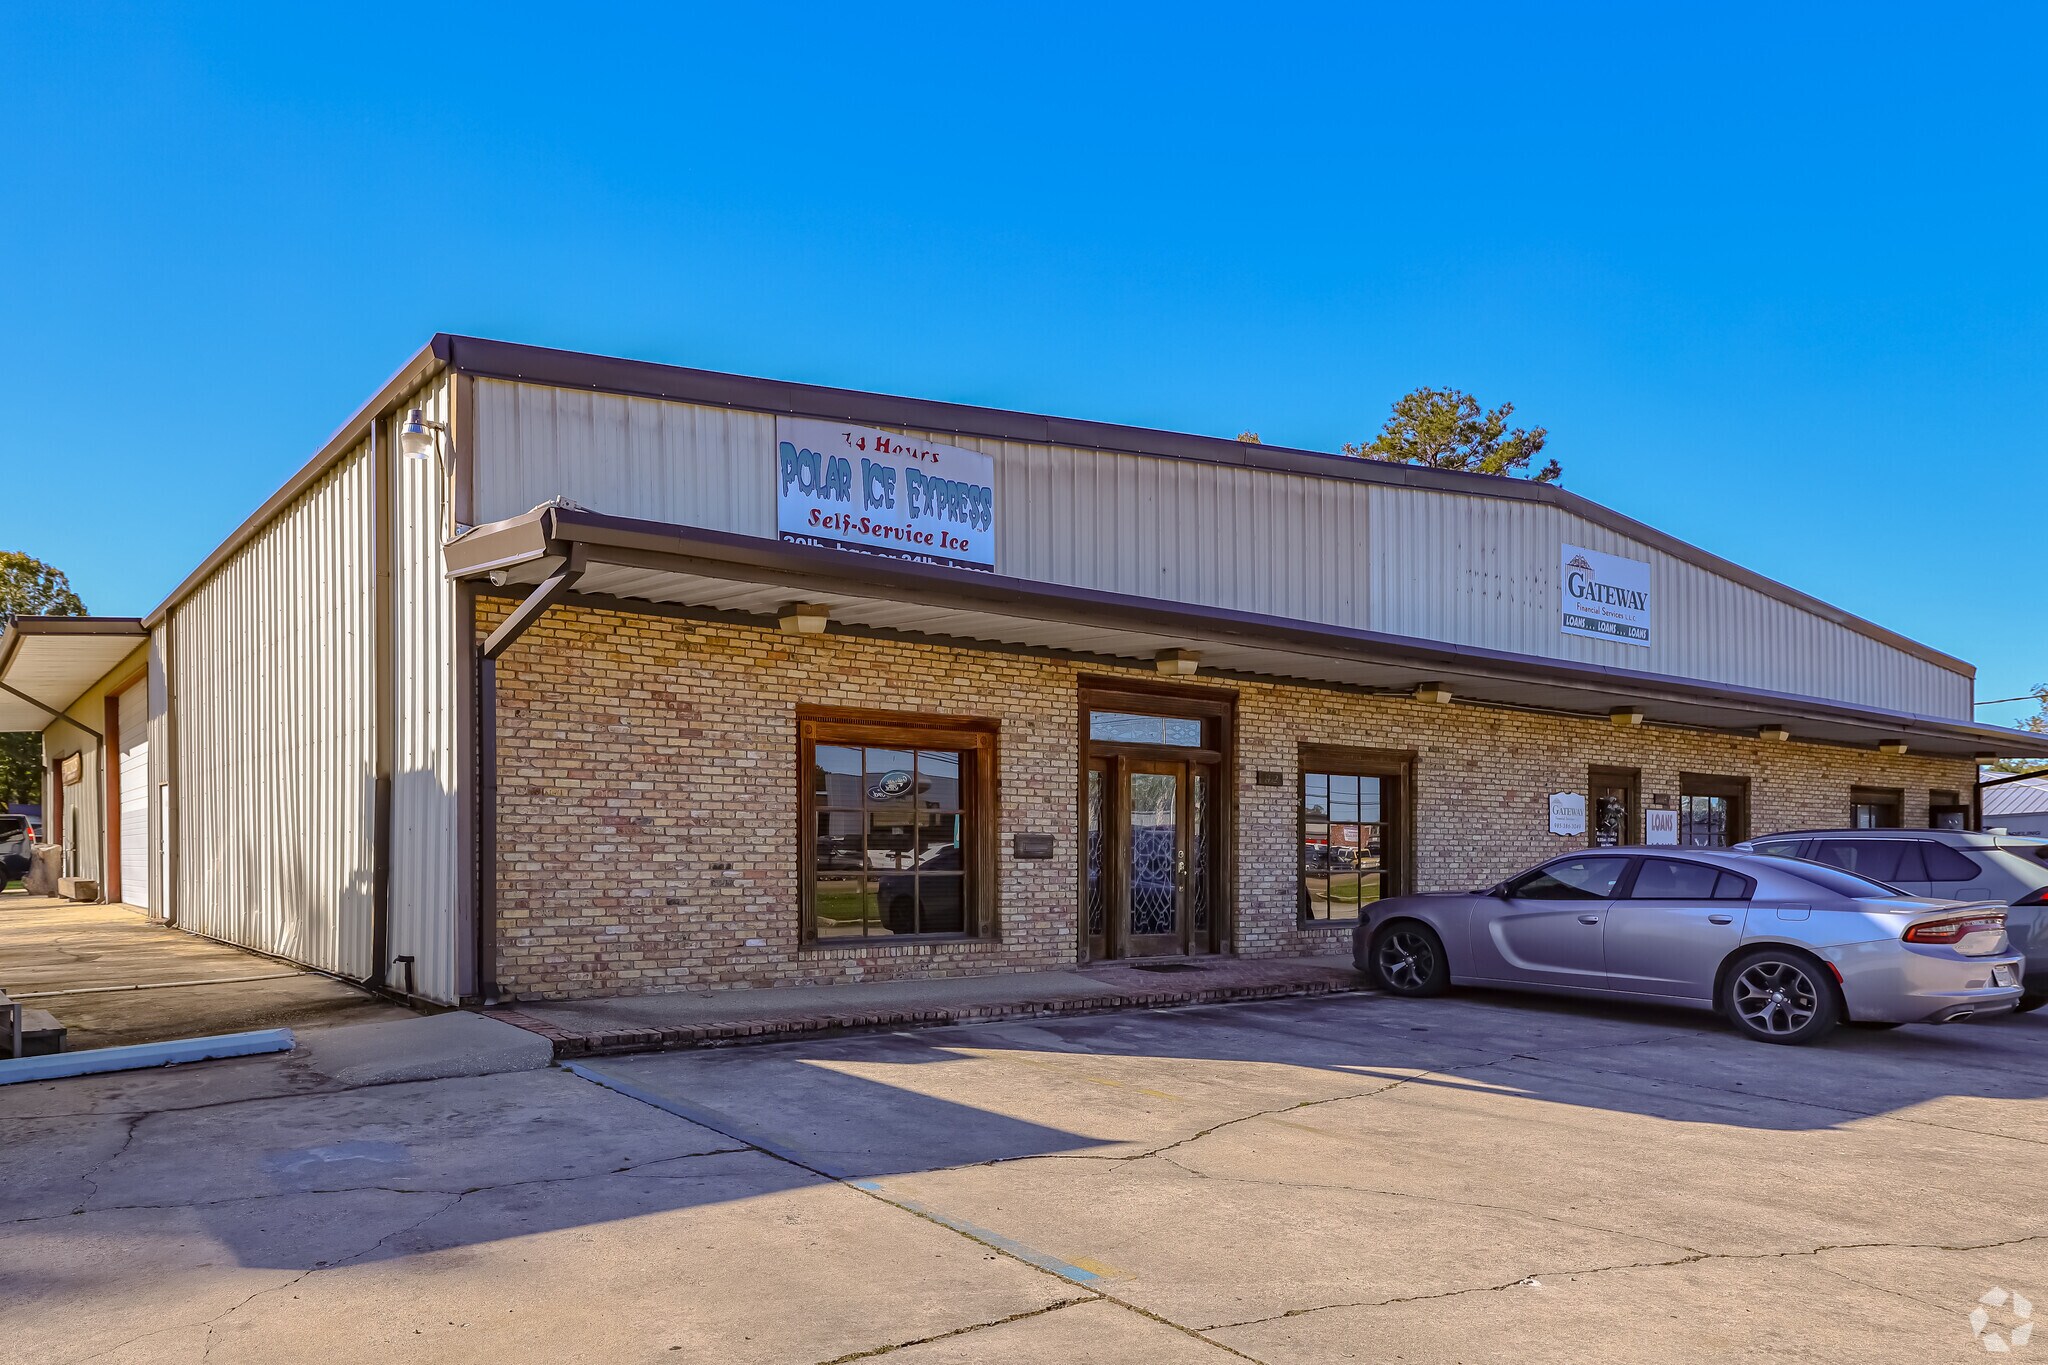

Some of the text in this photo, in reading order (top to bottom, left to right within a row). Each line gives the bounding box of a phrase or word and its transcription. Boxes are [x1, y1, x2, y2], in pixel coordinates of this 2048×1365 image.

[874, 436, 939, 463] Hours
[780, 441, 992, 532] POLAR ICE EXPRESS
[808, 508, 970, 552] Self-Service Ice
[1568, 572, 1648, 611] GATEWAY
[1576, 602, 1600, 615] Financial
[1602, 607, 1624, 619] Services
[1629, 627, 1647, 639] LOANS
[1552, 805, 1585, 816] GATEWAY
[1651, 814, 1673, 832] LOANS
